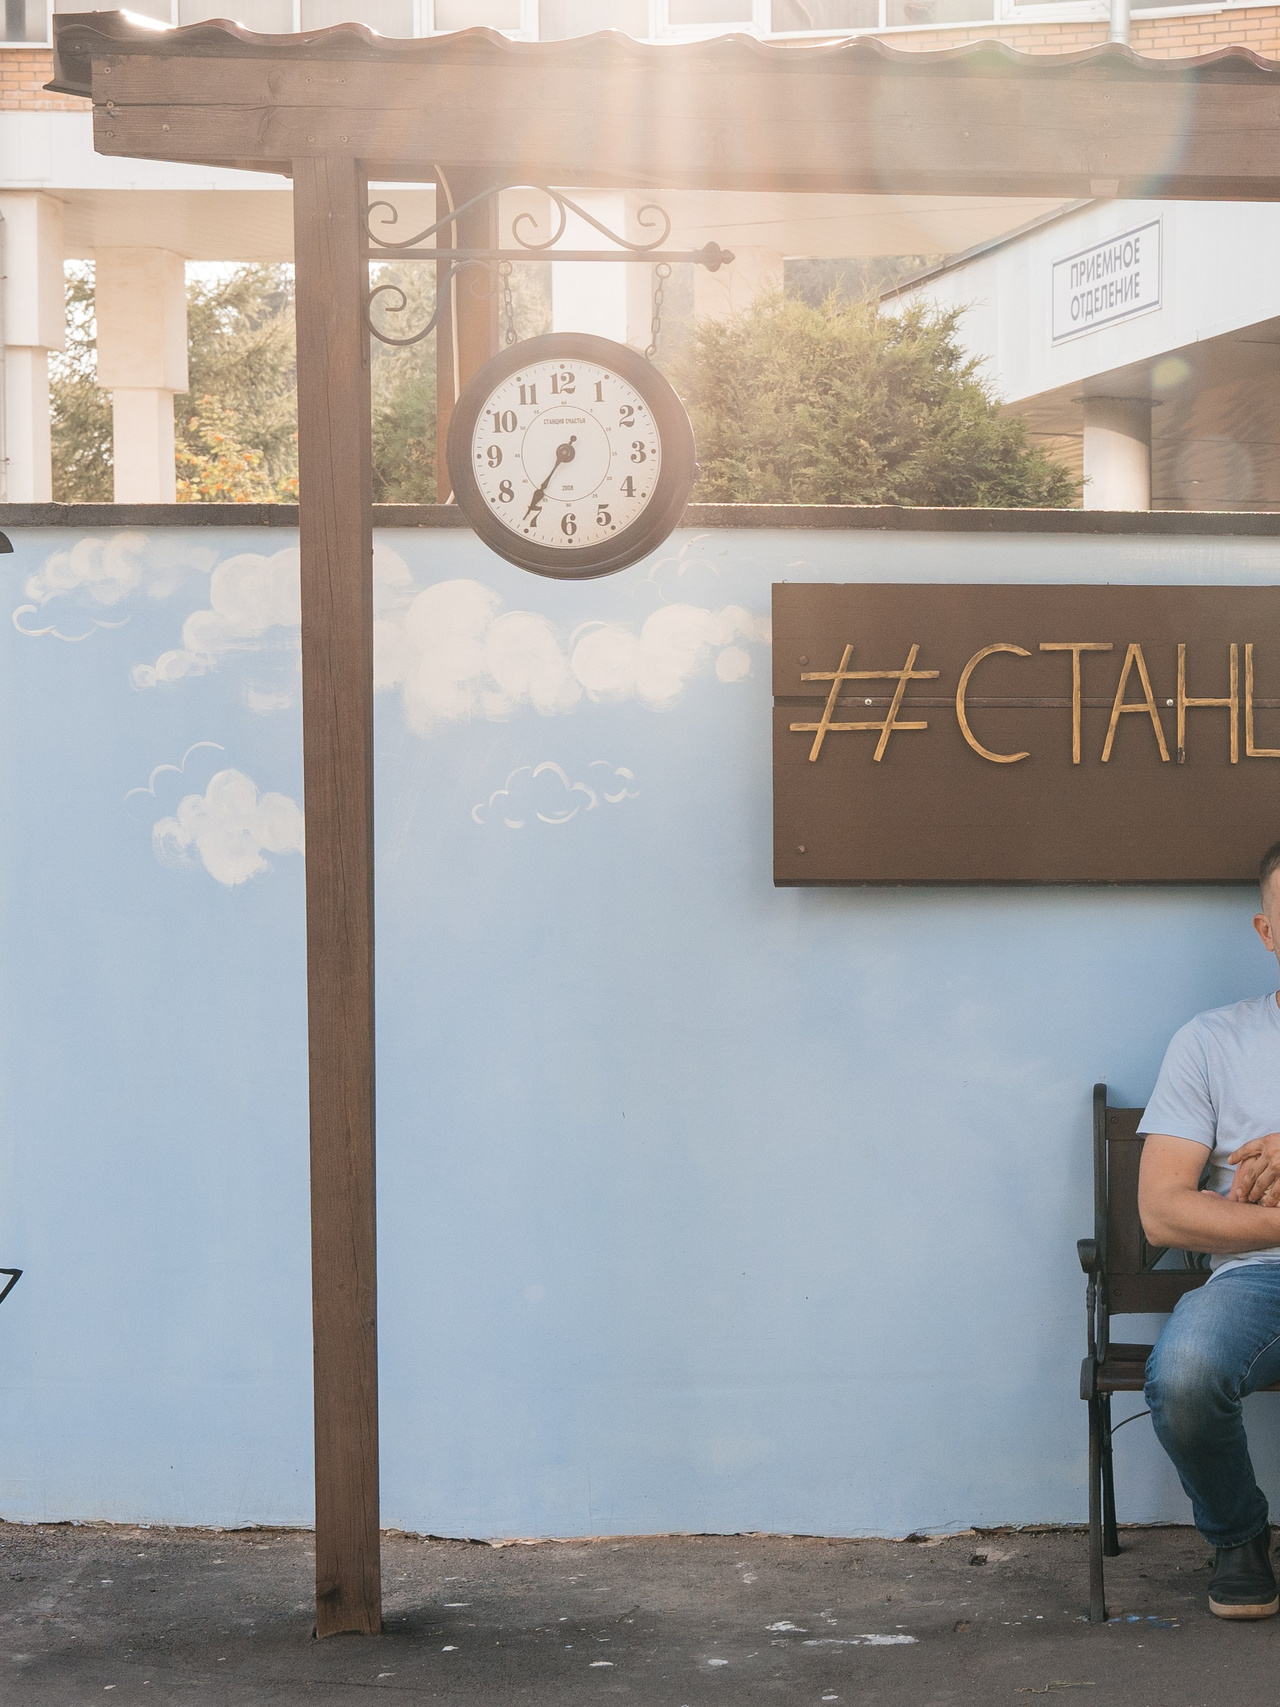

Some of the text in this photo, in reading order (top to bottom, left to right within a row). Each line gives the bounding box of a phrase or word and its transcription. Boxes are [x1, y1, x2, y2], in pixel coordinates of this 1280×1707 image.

[1070, 237, 1140, 290] ПРИЕМНОЕ
[1070, 271, 1140, 322] ОТДЕЛЕНИЕ
[518, 383, 539, 405] 11
[550, 372, 575, 394] 12
[594, 381, 605, 402] 1
[492, 410, 517, 433] 10
[619, 405, 634, 427] 2
[487, 445, 503, 468] 9
[630, 441, 646, 463] 3
[498, 480, 514, 503] 8
[620, 476, 636, 497] 4
[529, 506, 542, 527] 7
[561, 513, 577, 535] 6
[597, 504, 611, 526] 5
